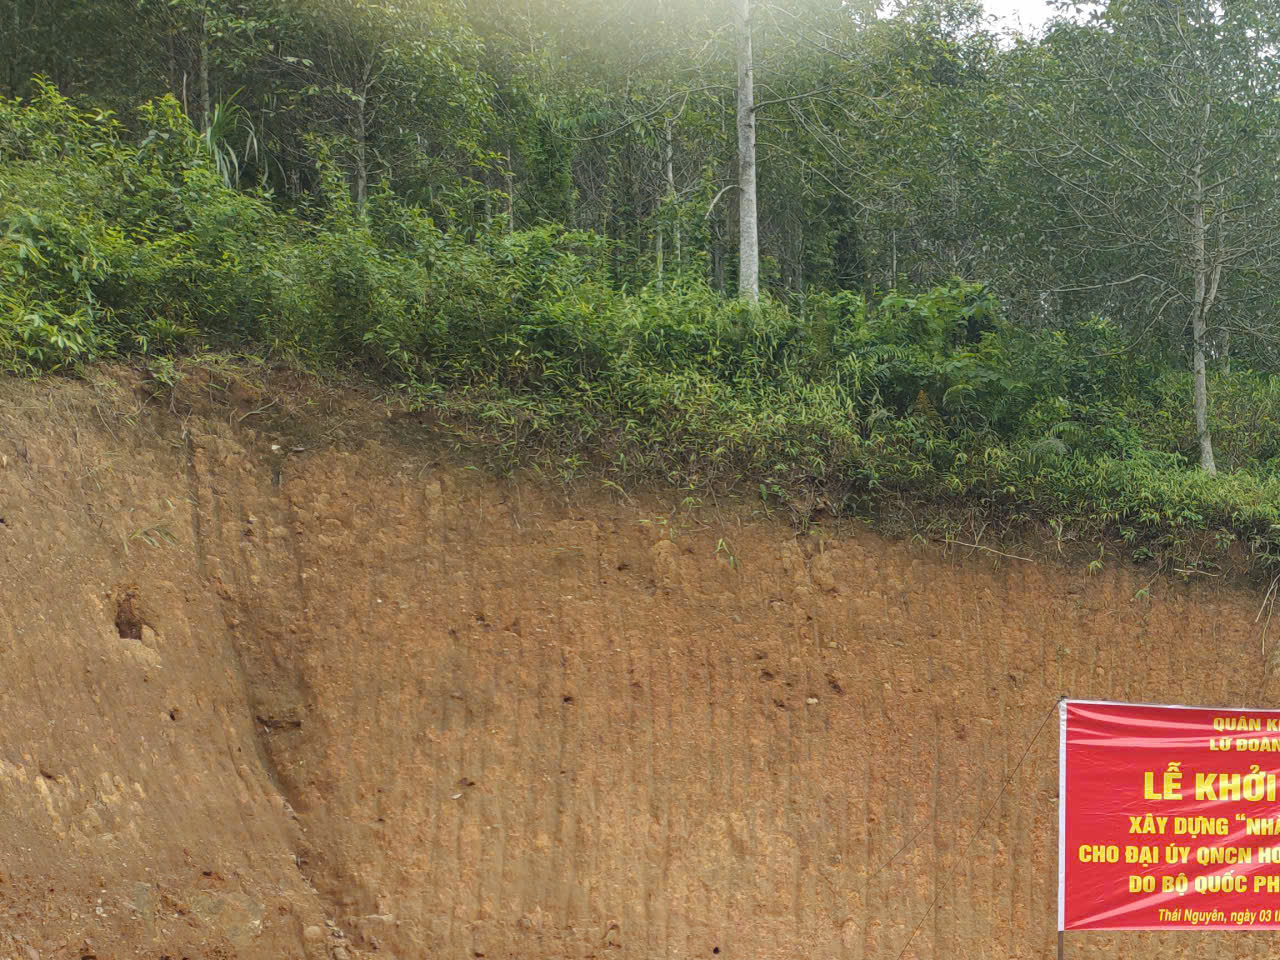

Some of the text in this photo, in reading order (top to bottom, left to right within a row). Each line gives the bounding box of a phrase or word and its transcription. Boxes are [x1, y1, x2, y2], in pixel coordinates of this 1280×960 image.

[1213, 716, 1261, 731] QUÂN
[1144, 762, 1183, 800] LỄ
[1195, 764, 1276, 802] KHỞI
[1129, 813, 1168, 834] XÂY
[1174, 815, 1229, 838] DỰNG
[1078, 845, 1119, 864] CHO
[1125, 845, 1159, 867] ĐẠI
[1165, 843, 1191, 864] ÚY
[1196, 846, 1252, 866] QNCN
[1129, 875, 1155, 893] DO
[1162, 872, 1188, 896] BỘ
[1194, 870, 1248, 894] QUỐC
[1158, 908, 1181, 922] Thái
[1183, 909, 1228, 925] Nguyên,
[1230, 909, 1257, 925] ngày
[1259, 909, 1272, 922] 03
